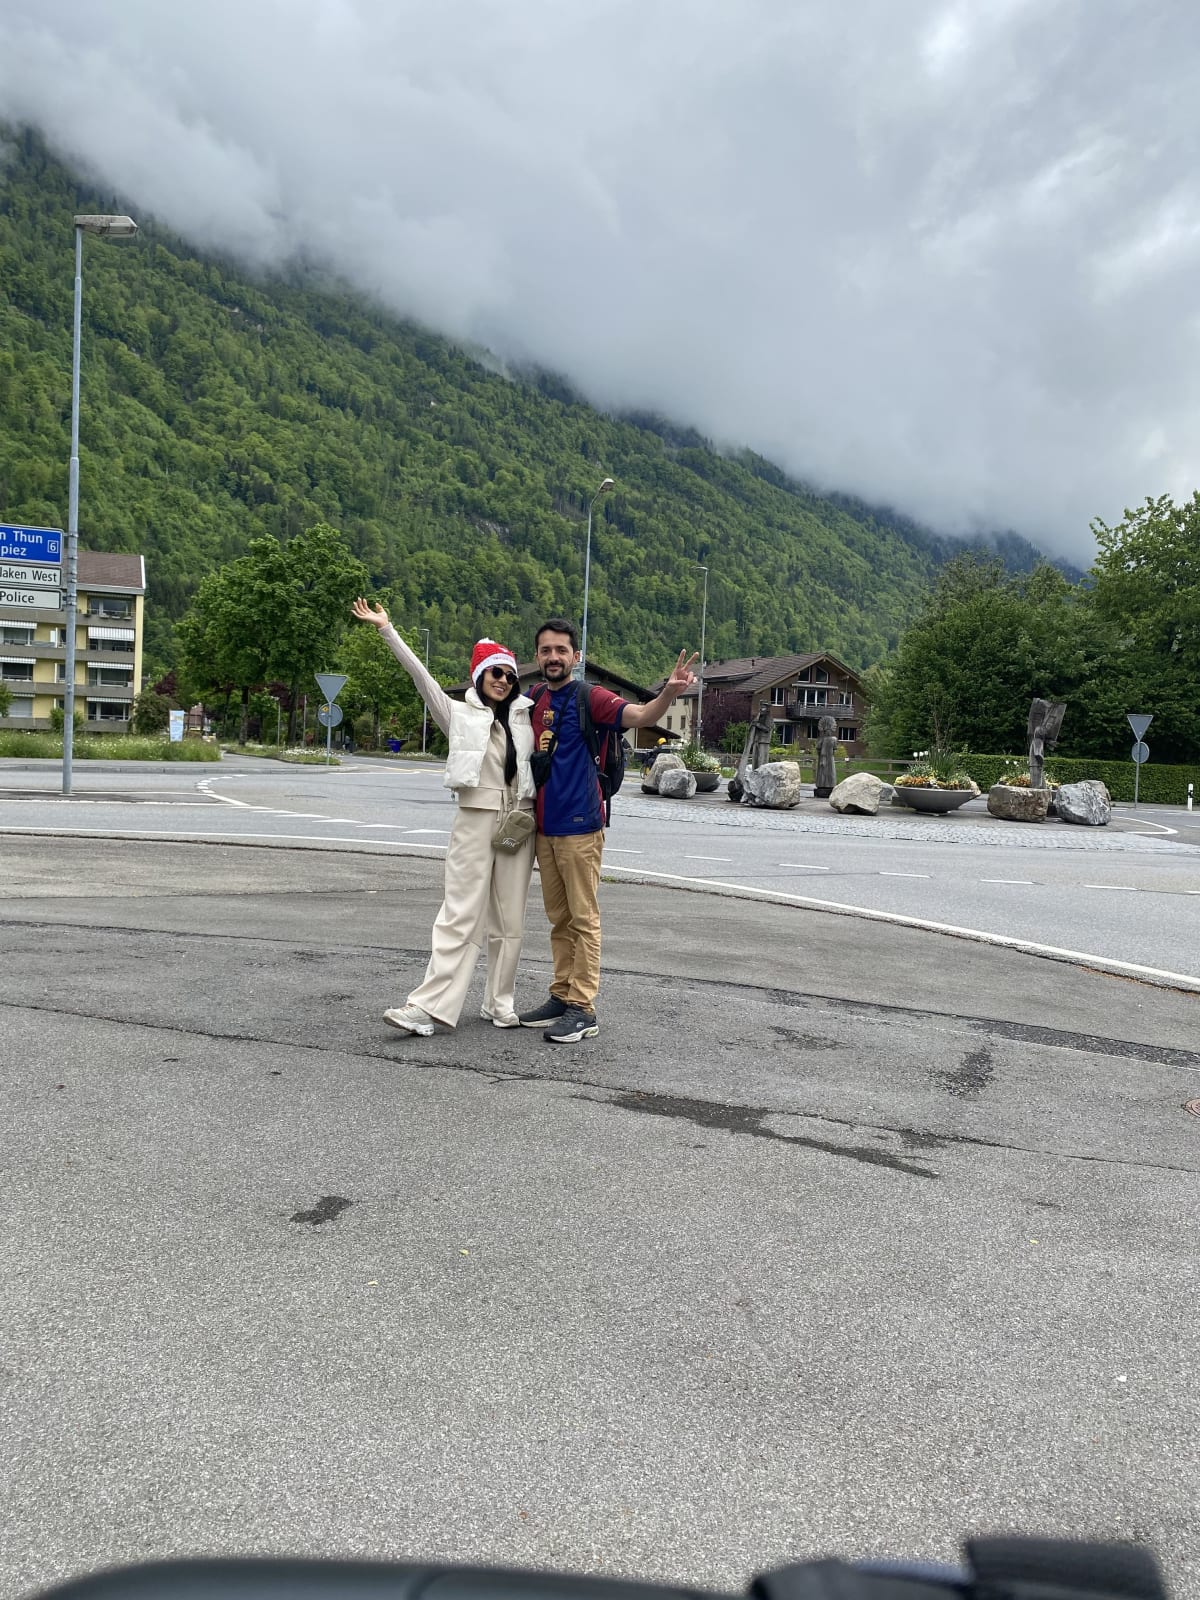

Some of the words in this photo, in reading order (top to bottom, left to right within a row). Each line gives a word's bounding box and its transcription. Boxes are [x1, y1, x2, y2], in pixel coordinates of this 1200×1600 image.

[13, 530, 43, 544] Thun
[1, 543, 27, 556] piez
[50, 542, 56, 551] 6
[32, 570, 57, 582] West
[0, 590, 34, 603] Police
